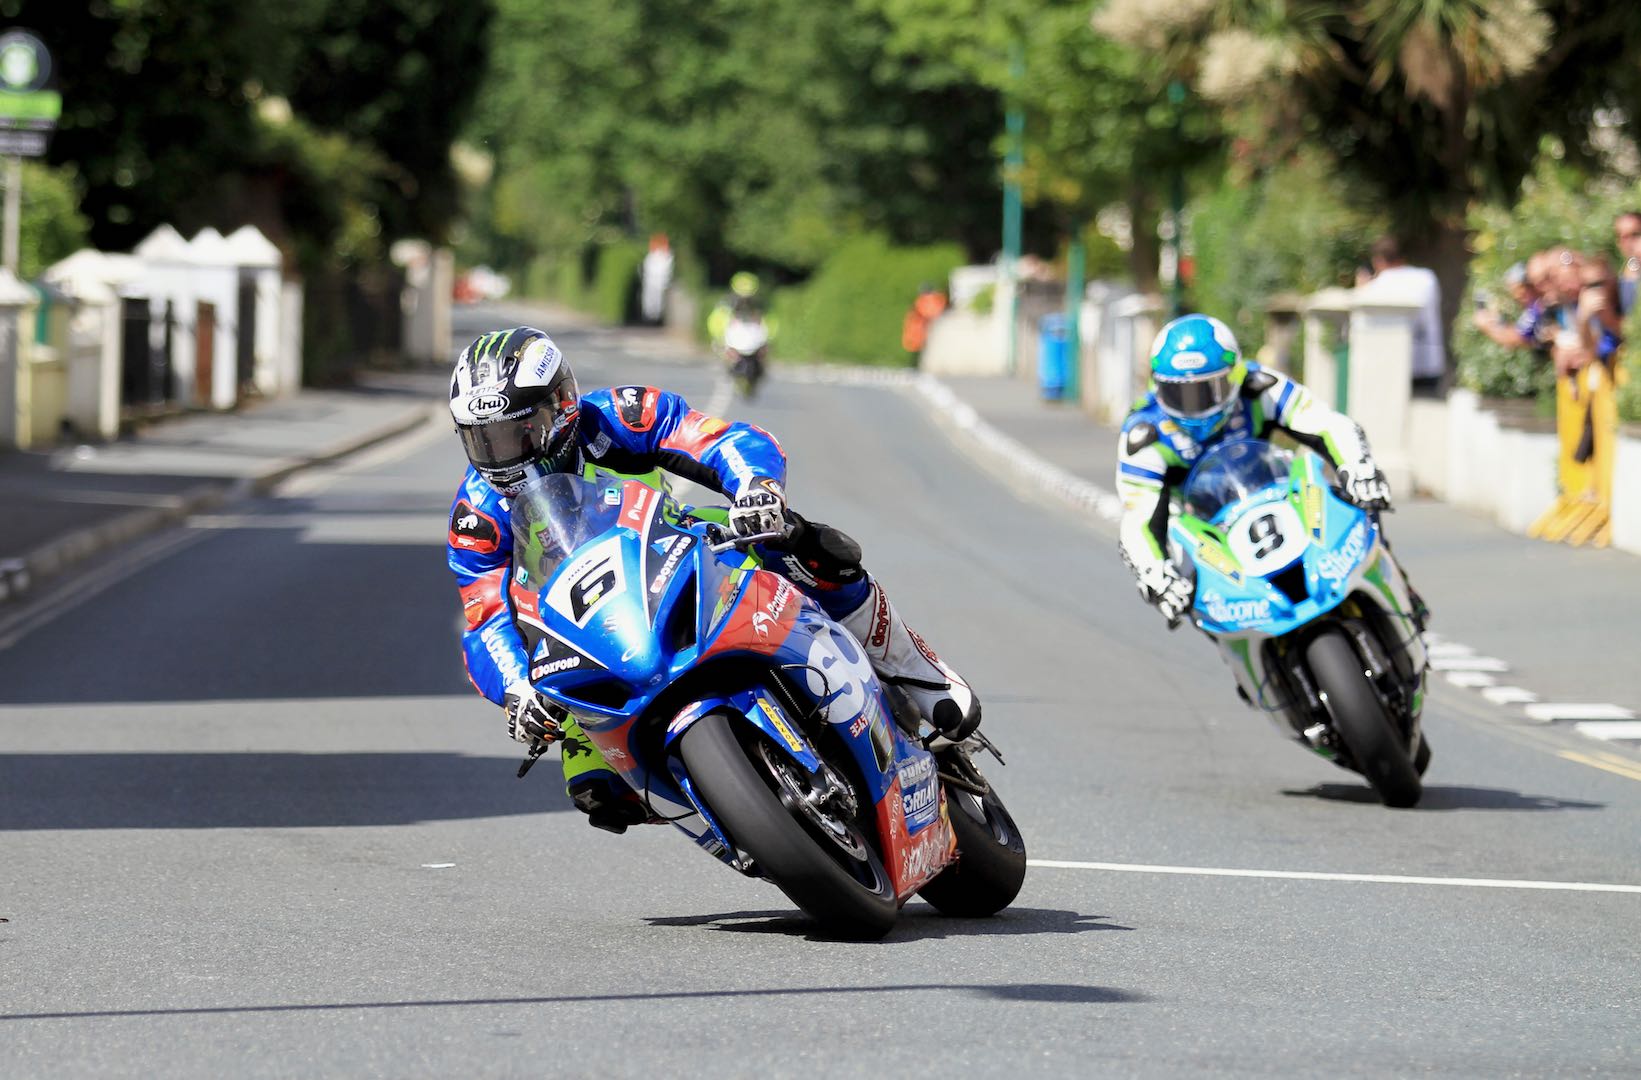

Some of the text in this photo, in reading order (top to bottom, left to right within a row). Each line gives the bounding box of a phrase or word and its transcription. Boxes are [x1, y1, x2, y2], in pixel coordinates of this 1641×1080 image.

[471, 396, 502, 412] Arai
[660, 536, 692, 576] OXFORD
[1249, 513, 1284, 559] 9
[570, 556, 616, 622] 6
[543, 656, 580, 676] OXFORD
